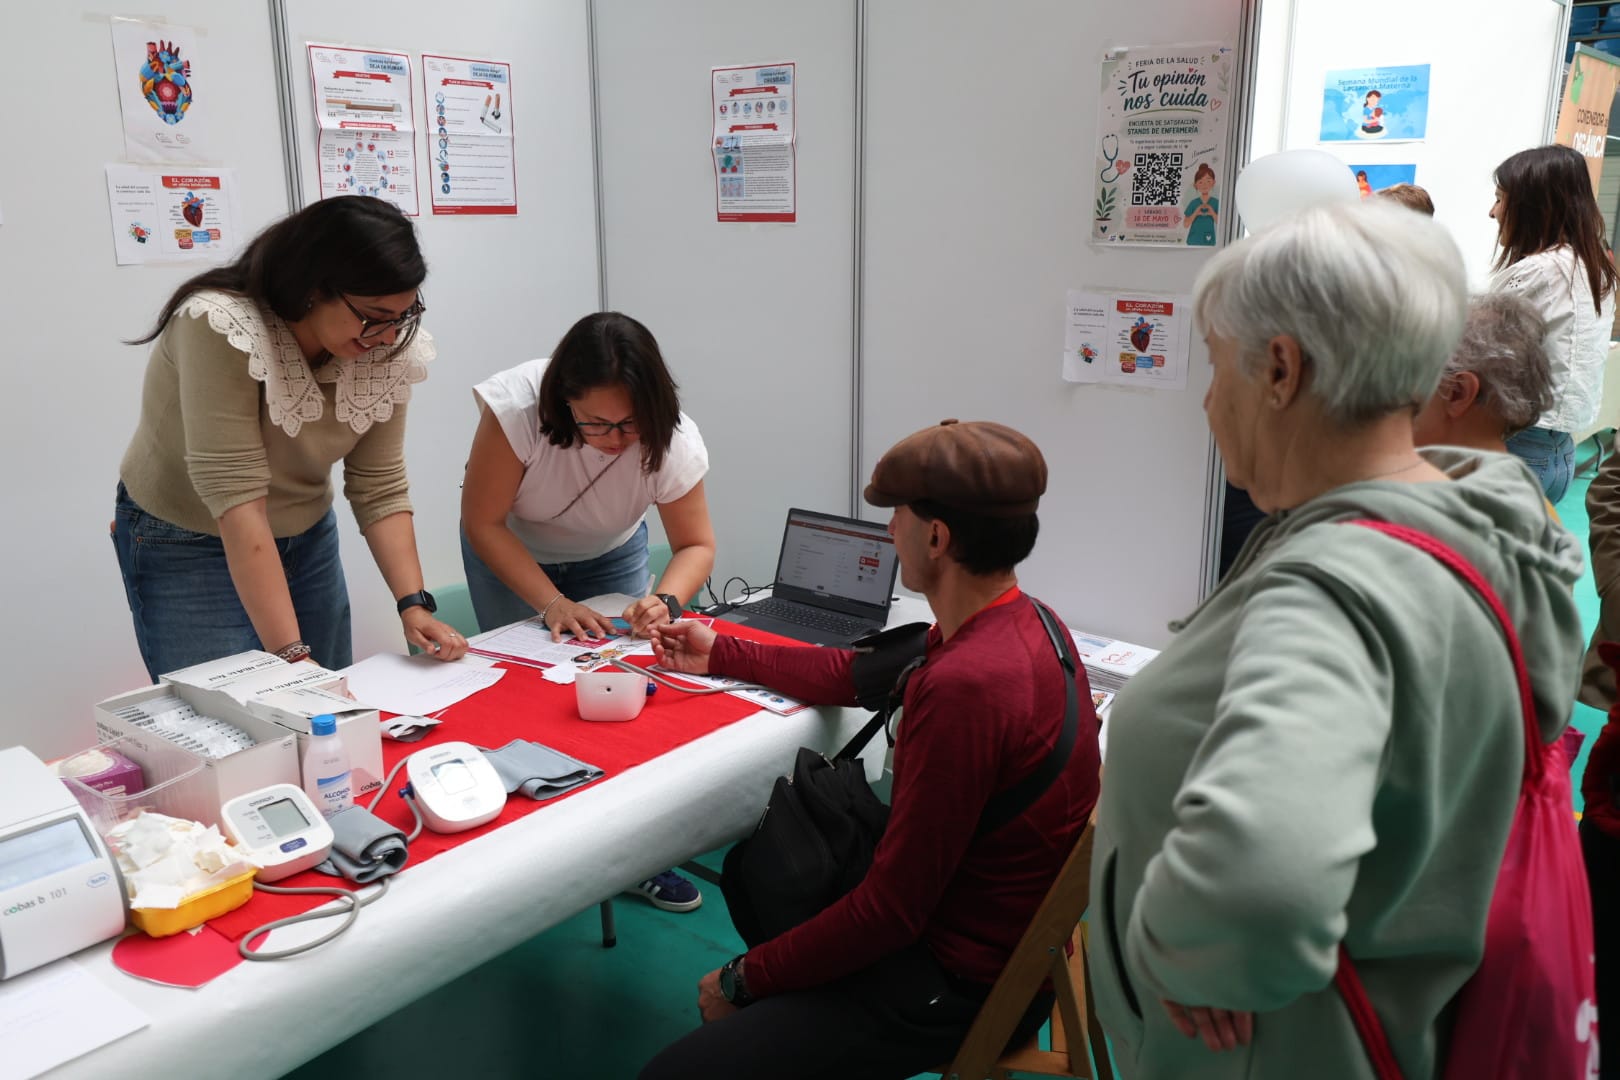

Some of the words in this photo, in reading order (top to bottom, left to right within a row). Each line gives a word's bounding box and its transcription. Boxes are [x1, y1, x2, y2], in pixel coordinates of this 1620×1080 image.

[1128, 70, 1149, 94] Tu
[1153, 70, 1206, 93] opinión
[1124, 93, 1154, 111] nos
[1160, 87, 1208, 107] cuida
[1161, 126, 1198, 134] ENFERMERÍA
[3, 900, 36, 916] cobas
[37, 896, 45, 904] b
[49, 888, 67, 900] 101
